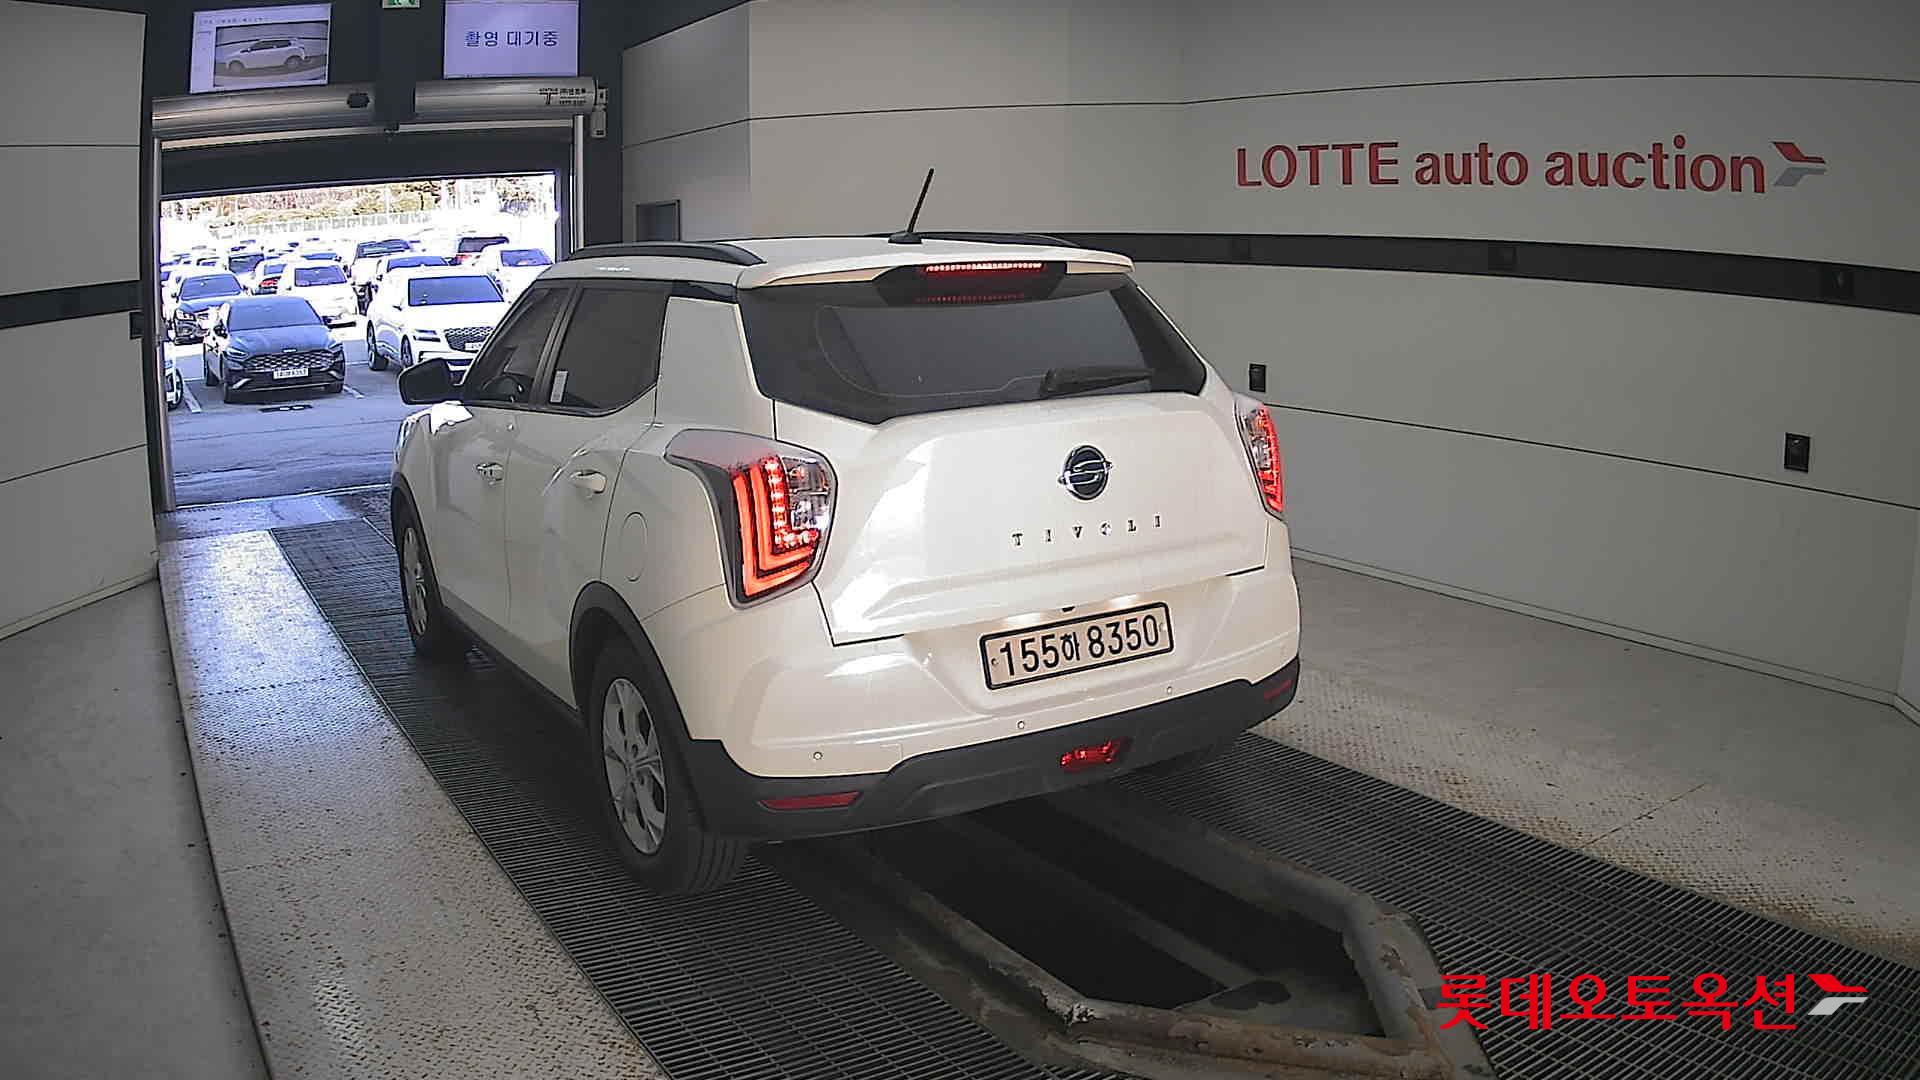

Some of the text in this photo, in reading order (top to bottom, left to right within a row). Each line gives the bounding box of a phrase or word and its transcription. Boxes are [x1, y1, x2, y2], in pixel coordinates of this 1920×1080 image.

[465, 31, 559, 47] 촬영 대기중
[1236, 135, 1766, 194] LOTTE auto auction
[1012, 515, 1161, 546] TIVOLI
[999, 615, 1160, 676] 155하 8350
